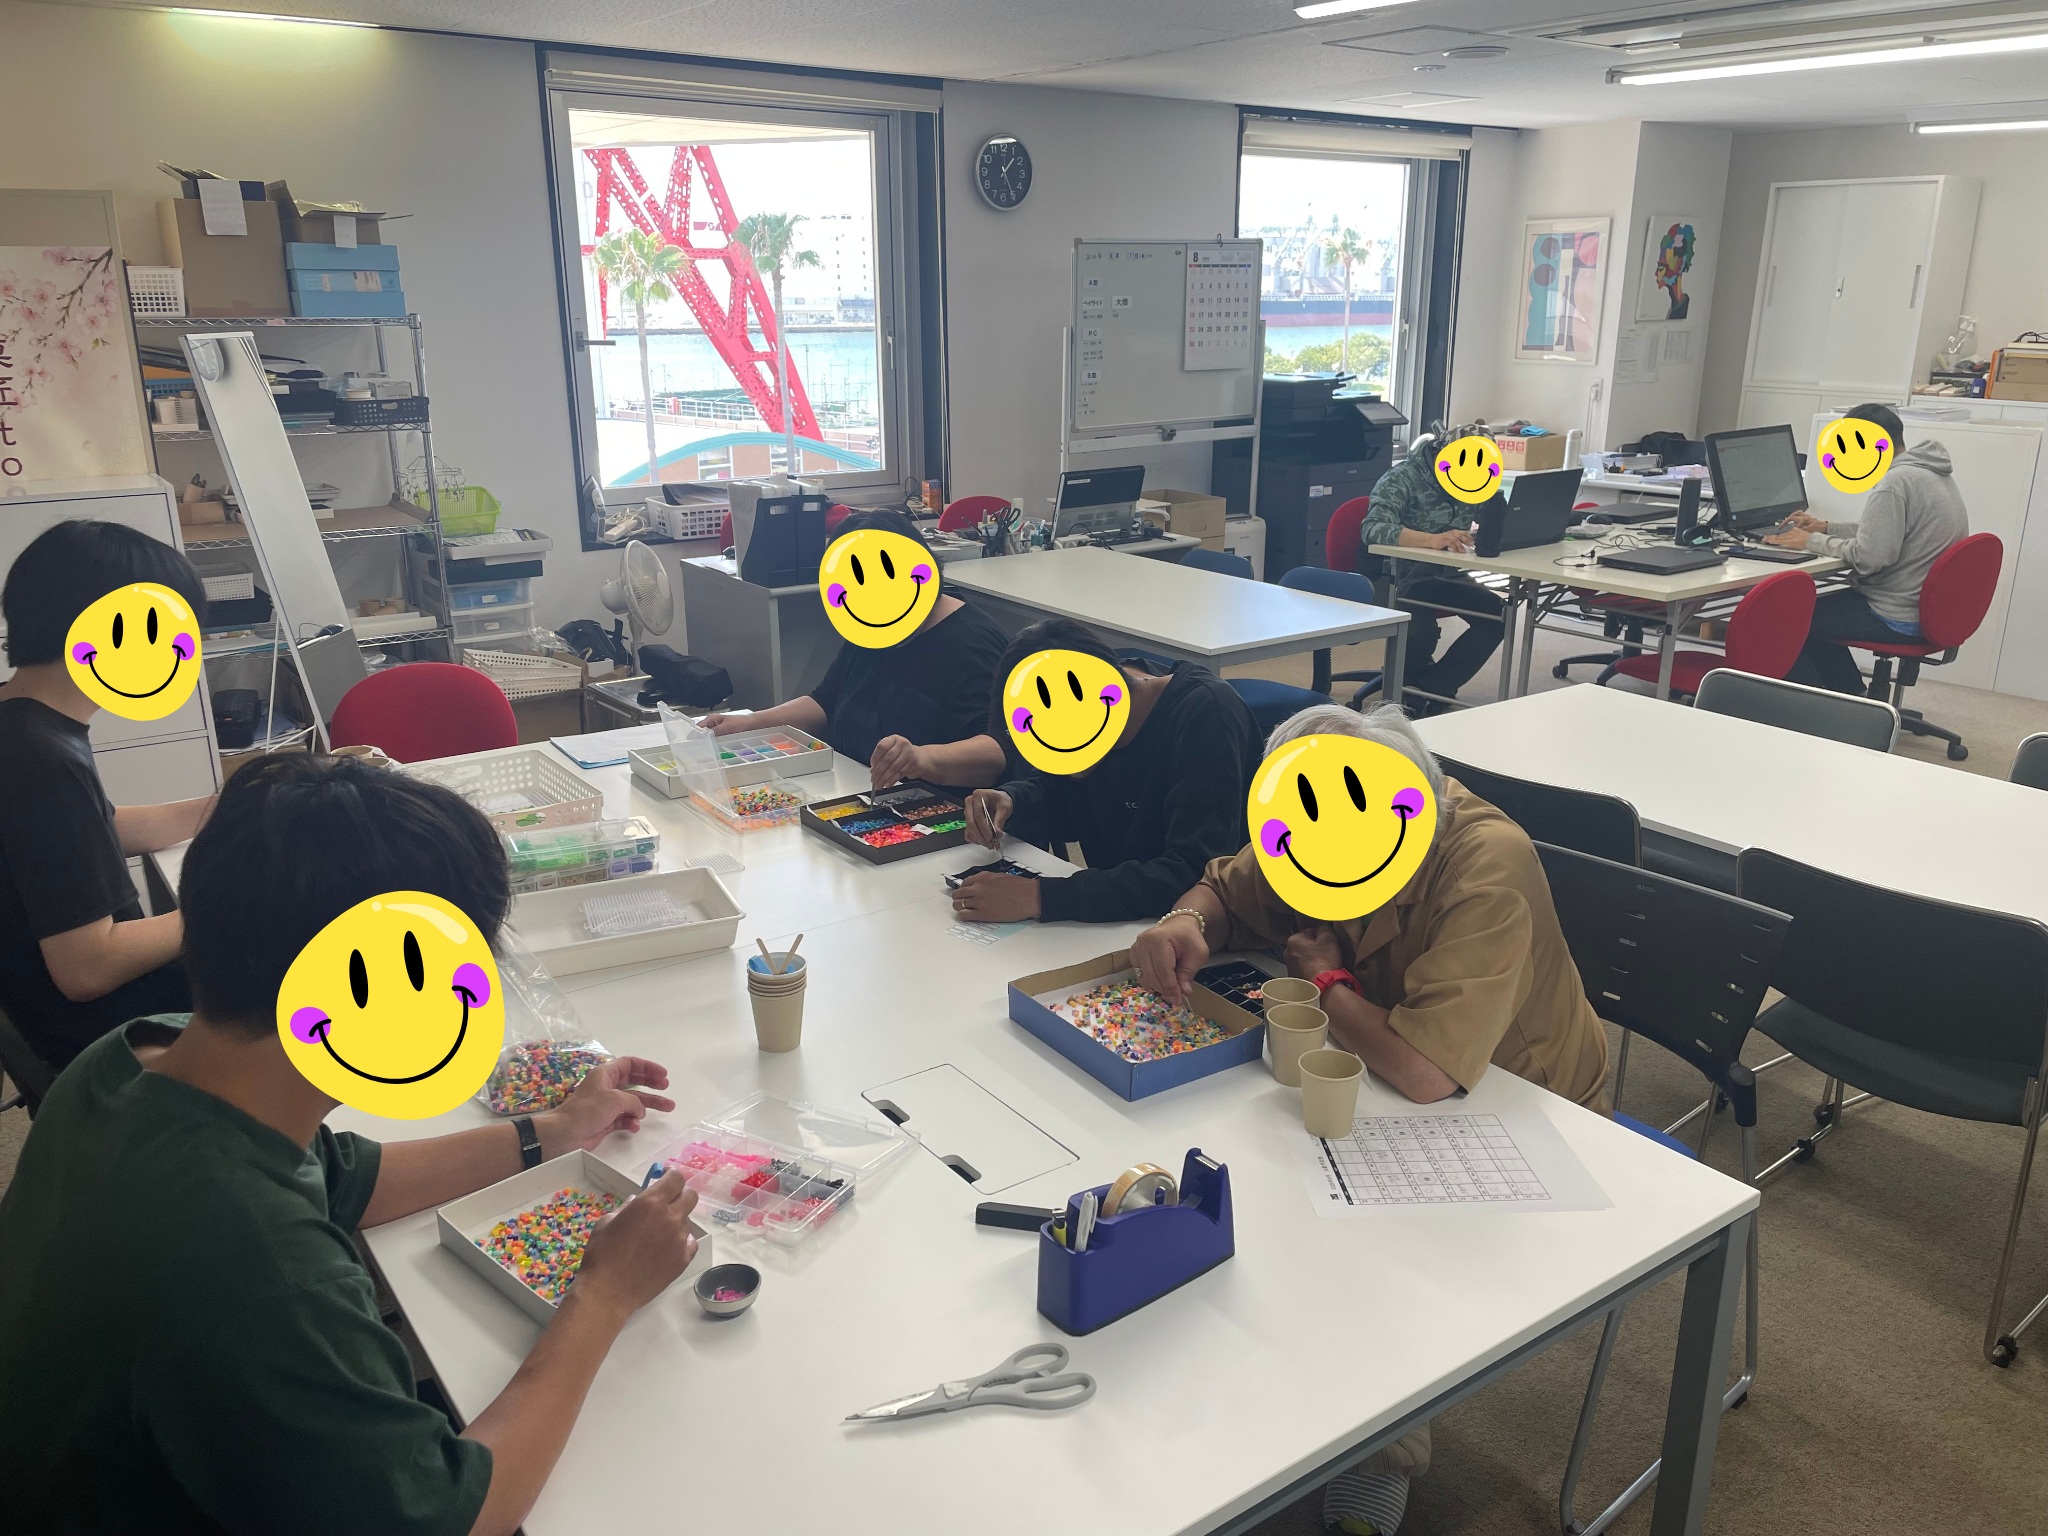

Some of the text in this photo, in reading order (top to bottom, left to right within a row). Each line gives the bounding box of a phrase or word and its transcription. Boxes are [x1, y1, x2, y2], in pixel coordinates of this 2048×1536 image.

[991, 145, 997, 154] 11
[1000, 143, 1008, 152] 12
[1011, 147, 1015, 155] 1
[984, 154, 992, 163] 10
[1017, 156, 1023, 165] 2
[981, 167, 988, 176] 9
[1019, 170, 1025, 178] 3
[985, 180, 990, 189] 8
[1016, 182, 1022, 190] 4
[992, 190, 997, 198] 7
[1000, 193, 1006, 202] 6
[1010, 191, 1016, 200] 5
[1193, 252, 1199, 262] 8
[1234, 296, 1240, 304] 14
[1198, 311, 1204, 319] 17
[1215, 325, 1222, 333] 26
